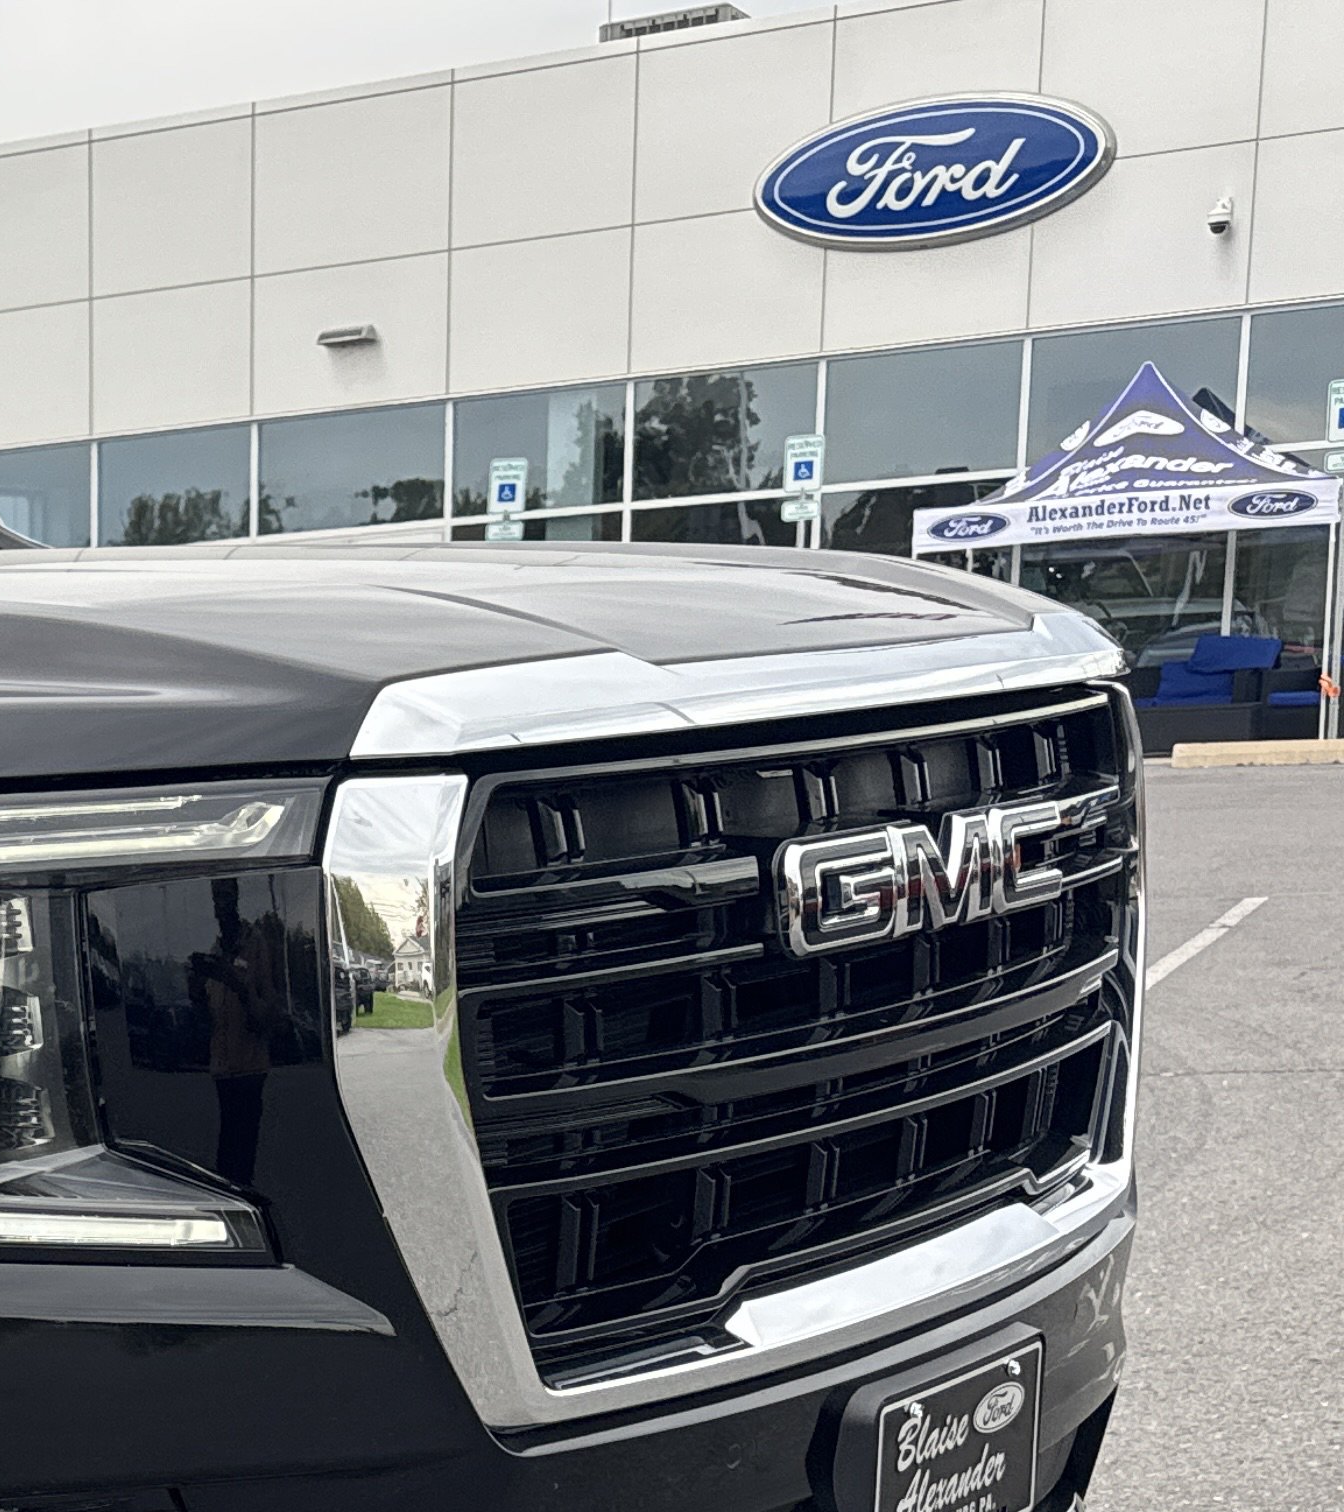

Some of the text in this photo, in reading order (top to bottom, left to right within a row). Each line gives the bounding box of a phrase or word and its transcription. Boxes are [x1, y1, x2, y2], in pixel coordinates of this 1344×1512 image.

[825, 127, 1026, 219] Ford
[1026, 494, 1211, 523] AlexanderFord.Net
[1246, 494, 1299, 515] Ford
[943, 516, 994, 538] Ford
[1052, 522, 1084, 534] Worth
[1086, 520, 1105, 530] The
[1106, 519, 1133, 529] Drive
[1136, 518, 1148, 526] To
[1150, 516, 1180, 526] Route
[780, 800, 1063, 957] GMC
[982, 1390, 1016, 1426] Ford
[896, 1413, 970, 1473] Blaise
